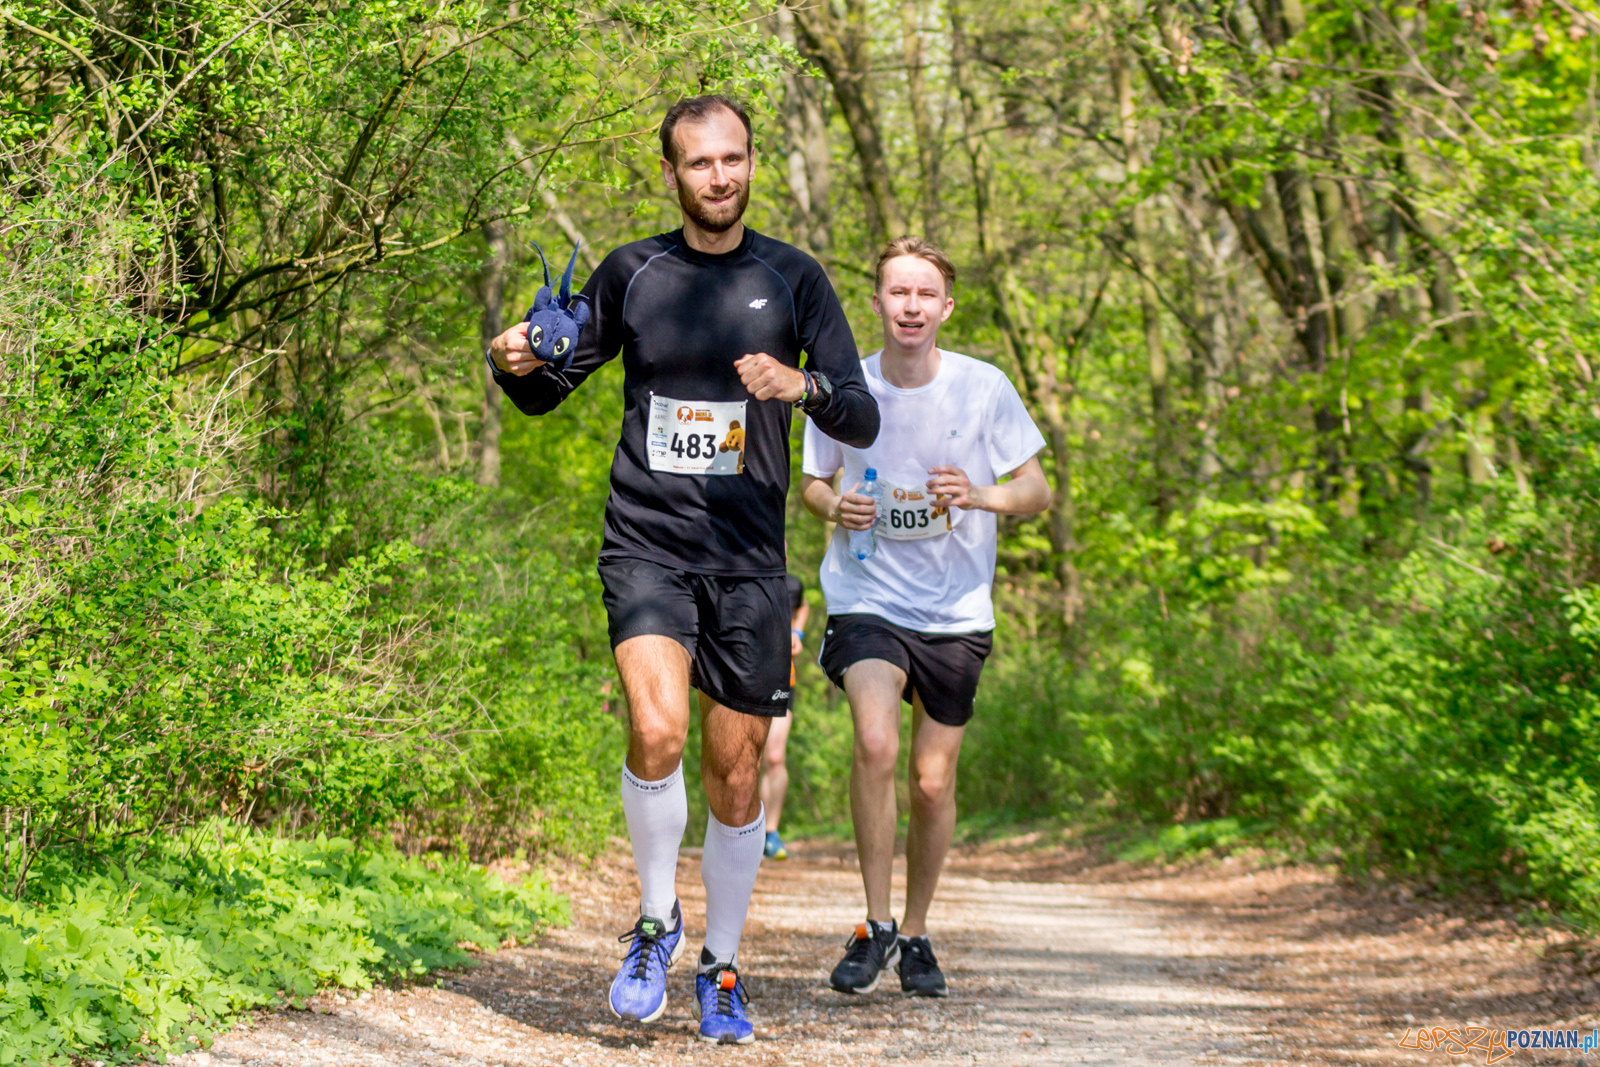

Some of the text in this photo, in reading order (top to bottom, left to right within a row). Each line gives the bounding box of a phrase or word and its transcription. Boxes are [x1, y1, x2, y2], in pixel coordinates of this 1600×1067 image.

[749, 298, 768, 310] 4F
[670, 432, 716, 459] 483
[890, 508, 930, 529] 603
